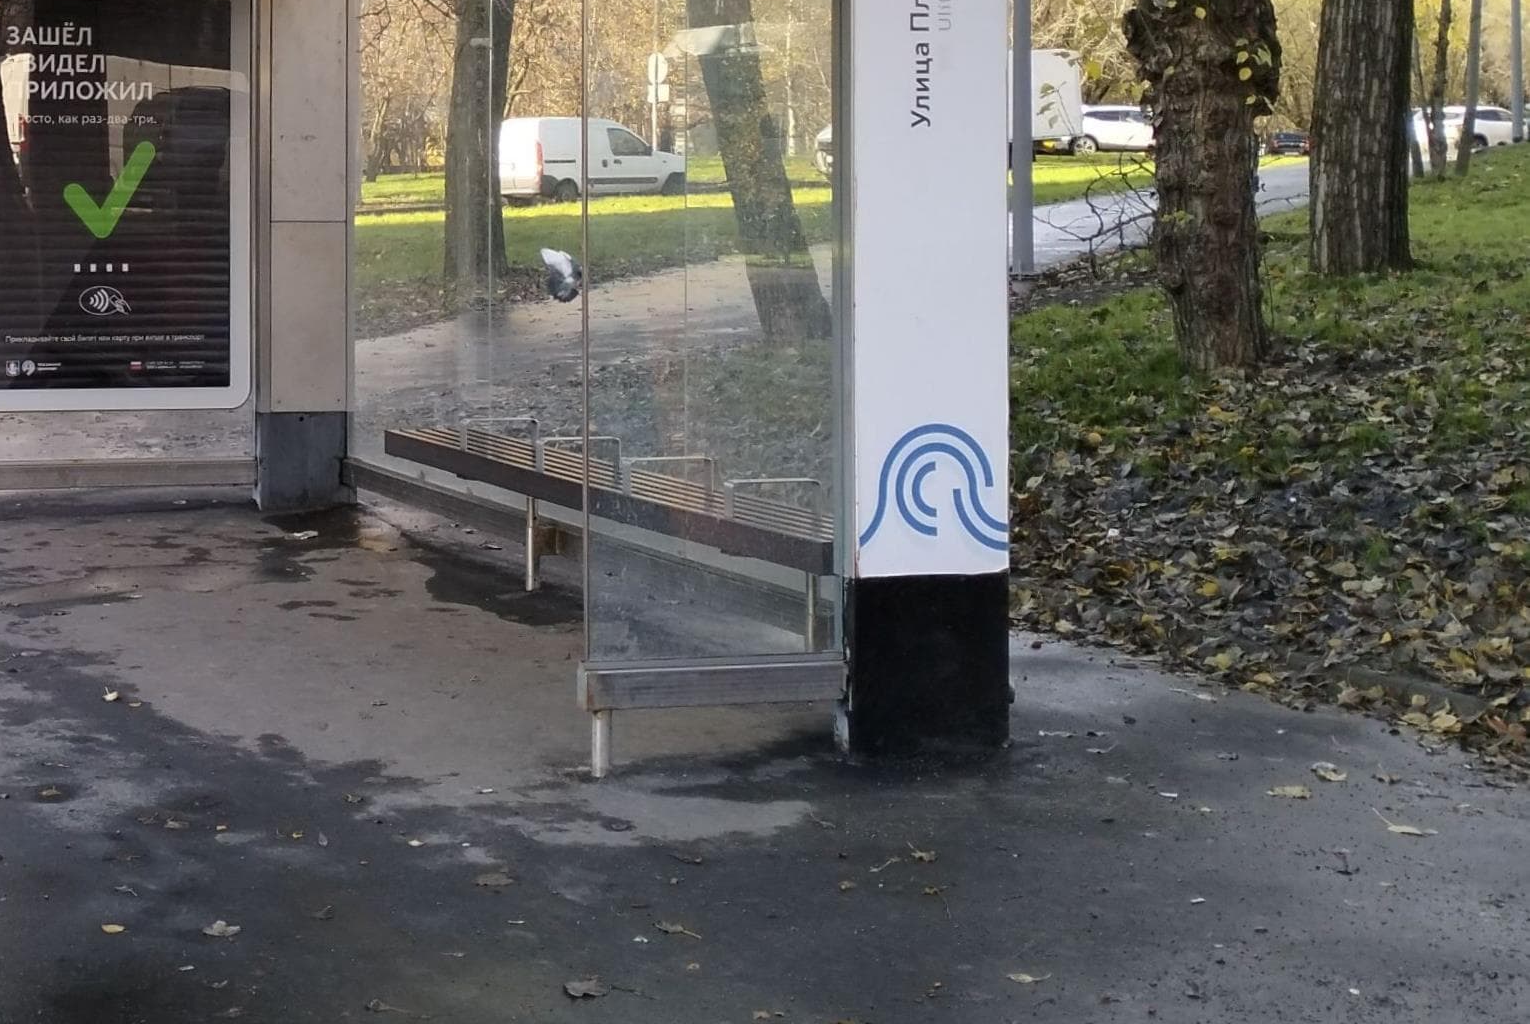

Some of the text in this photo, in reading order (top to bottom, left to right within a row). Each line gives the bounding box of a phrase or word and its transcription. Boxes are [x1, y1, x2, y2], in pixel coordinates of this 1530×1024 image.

[6, 22, 92, 46] ЗАШЁЛ
[6, 53, 106, 76] ВИДЕЛ
[6, 80, 153, 101] РИЛОЖИЛ
[910, 42, 932, 129] Улица
[7, 113, 55, 126] росто,
[58, 114, 79, 124] как
